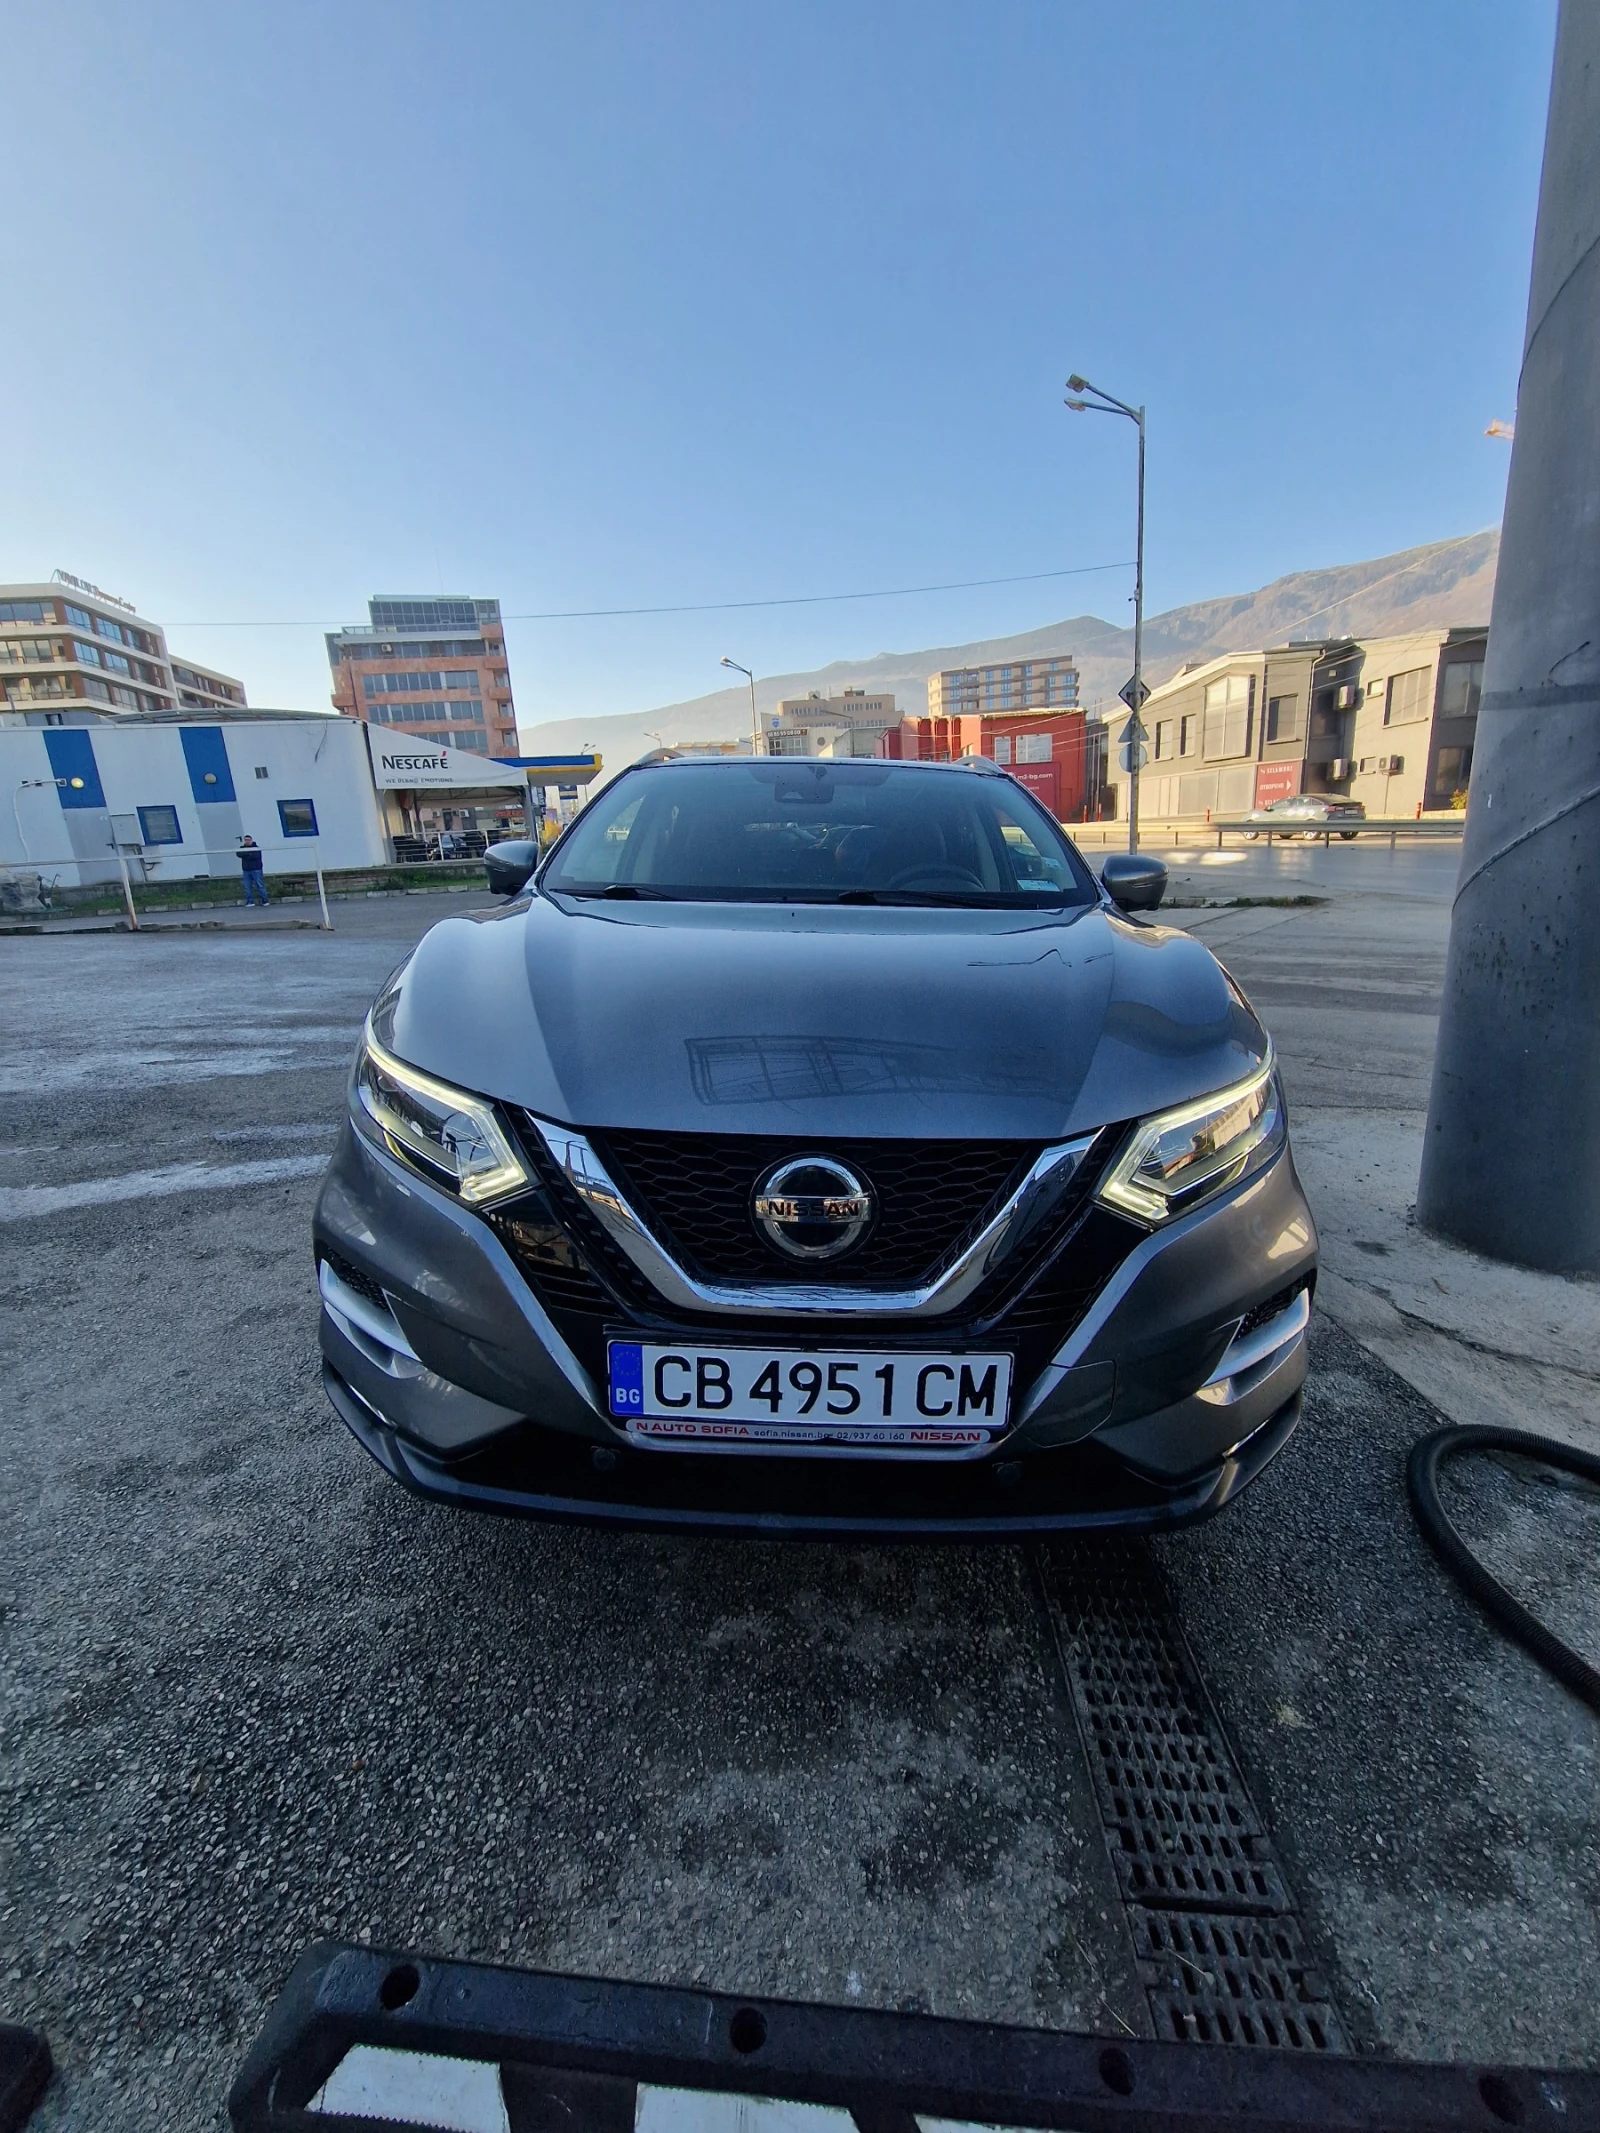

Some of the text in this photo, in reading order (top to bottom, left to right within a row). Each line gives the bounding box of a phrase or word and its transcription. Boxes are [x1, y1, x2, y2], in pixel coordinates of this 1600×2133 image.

[381, 750, 449, 770] NESCAFÉ
[768, 1201, 859, 1217] NISSAN
[654, 1355, 998, 1417] CB 4951 CM
[615, 1388, 640, 1404] BG
[635, 1422, 648, 1431] N
[651, 1422, 697, 1433] AUTO
[701, 1424, 750, 1435] SOFIA
[836, 1431, 871, 1440] 02/937
[873, 1432, 886, 1441] 60
[888, 1433, 905, 1441] 160
[910, 1431, 981, 1441] NISSAN
